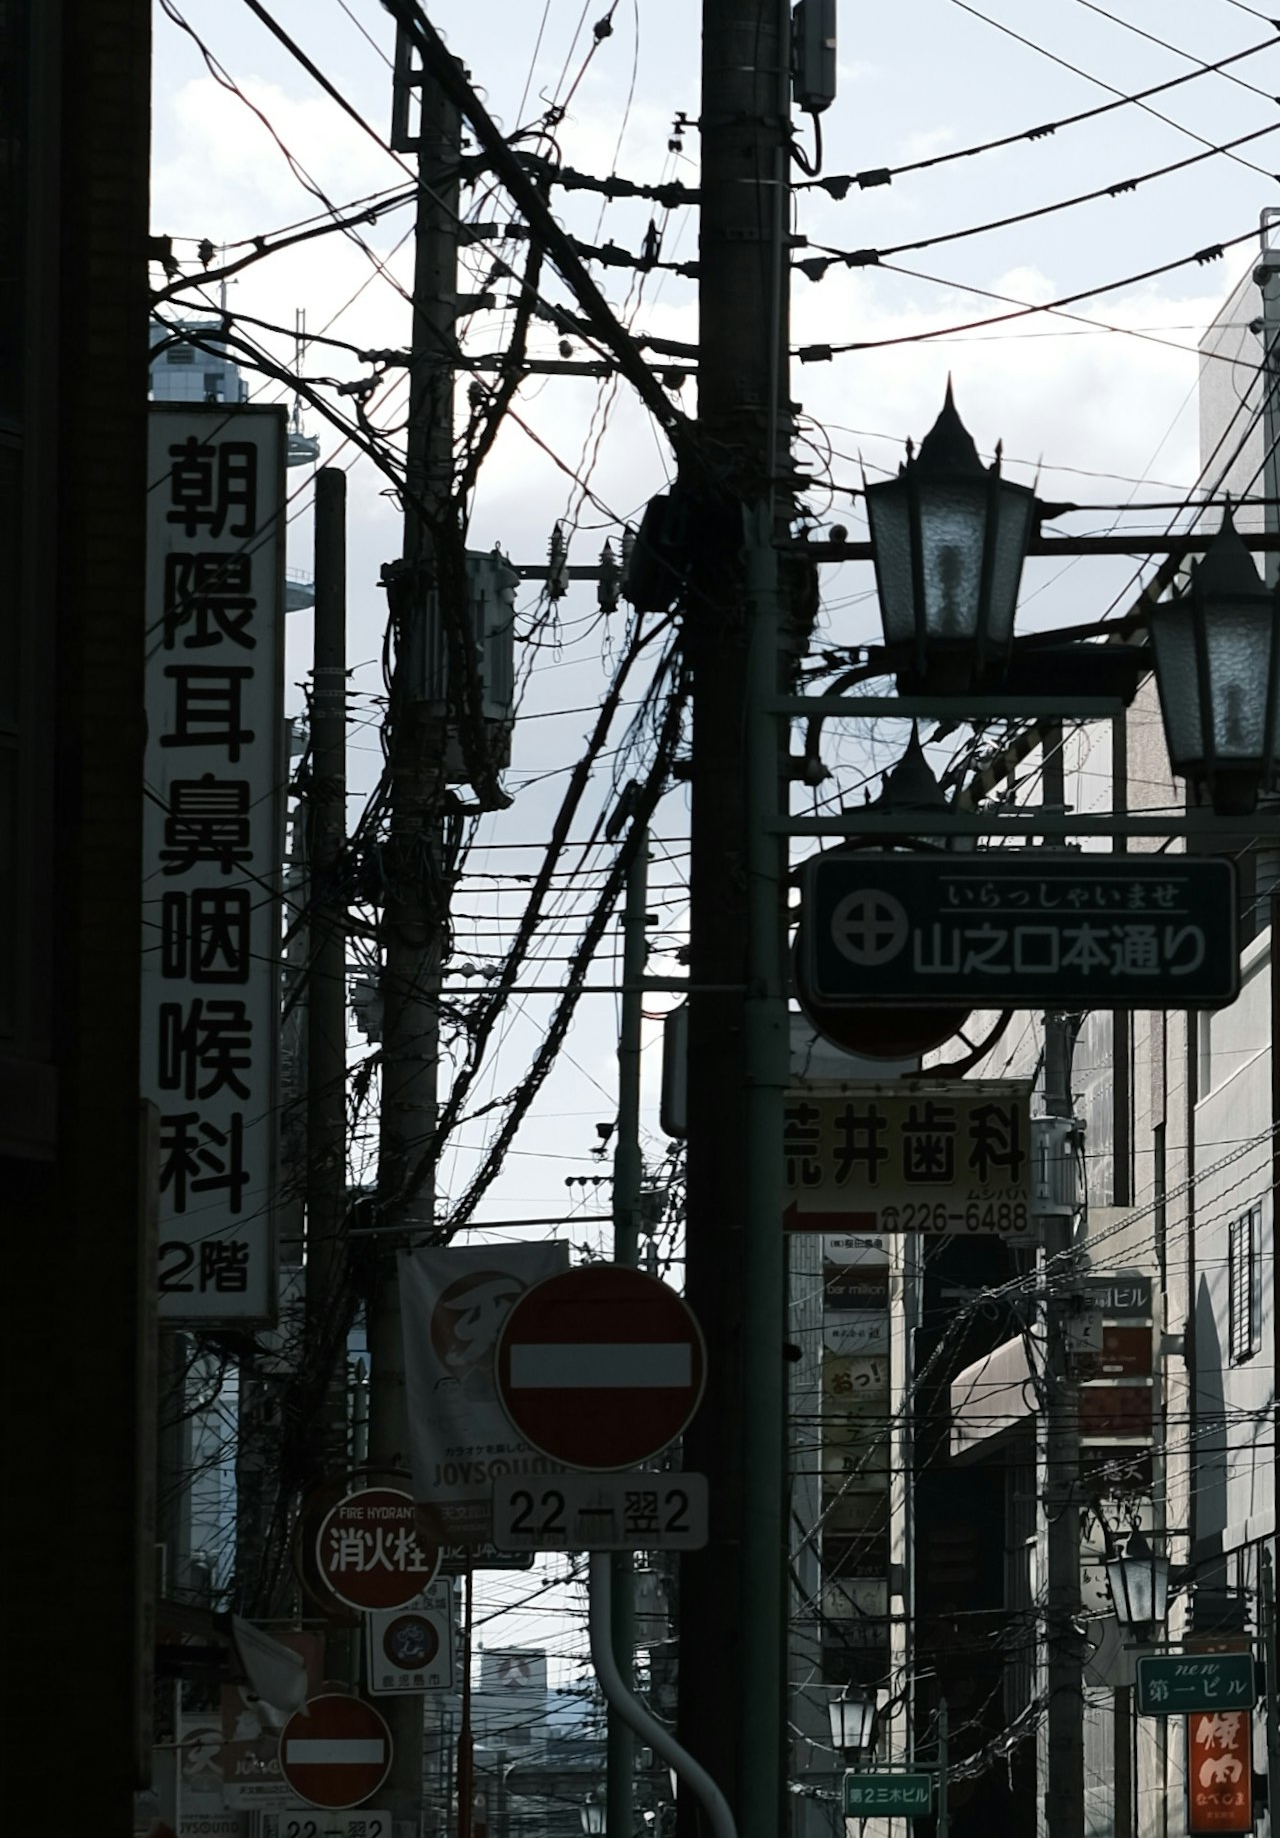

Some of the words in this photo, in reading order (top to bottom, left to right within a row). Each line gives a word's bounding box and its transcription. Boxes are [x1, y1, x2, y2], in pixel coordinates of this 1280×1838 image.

[158, 437, 258, 1214] 朝隈耳鼻咽喉科
[946, 877, 1181, 911] いらっしゃいませ
[913, 923, 1207, 979] 山之口本通り
[783, 1098, 1026, 1186] 荒井歯科
[967, 1188, 1028, 1200] ムシバハ
[902, 1203, 1028, 1231] 226-6488
[158, 1237, 249, 1295] 2階
[339, 1506, 364, 1520] FIRE
[329, 1526, 429, 1573] 消火栓
[1174, 1664, 1221, 1677] new
[1148, 1677, 1249, 1702] 第一ビル
[849, 1786, 929, 1805] 第2三木ビル
